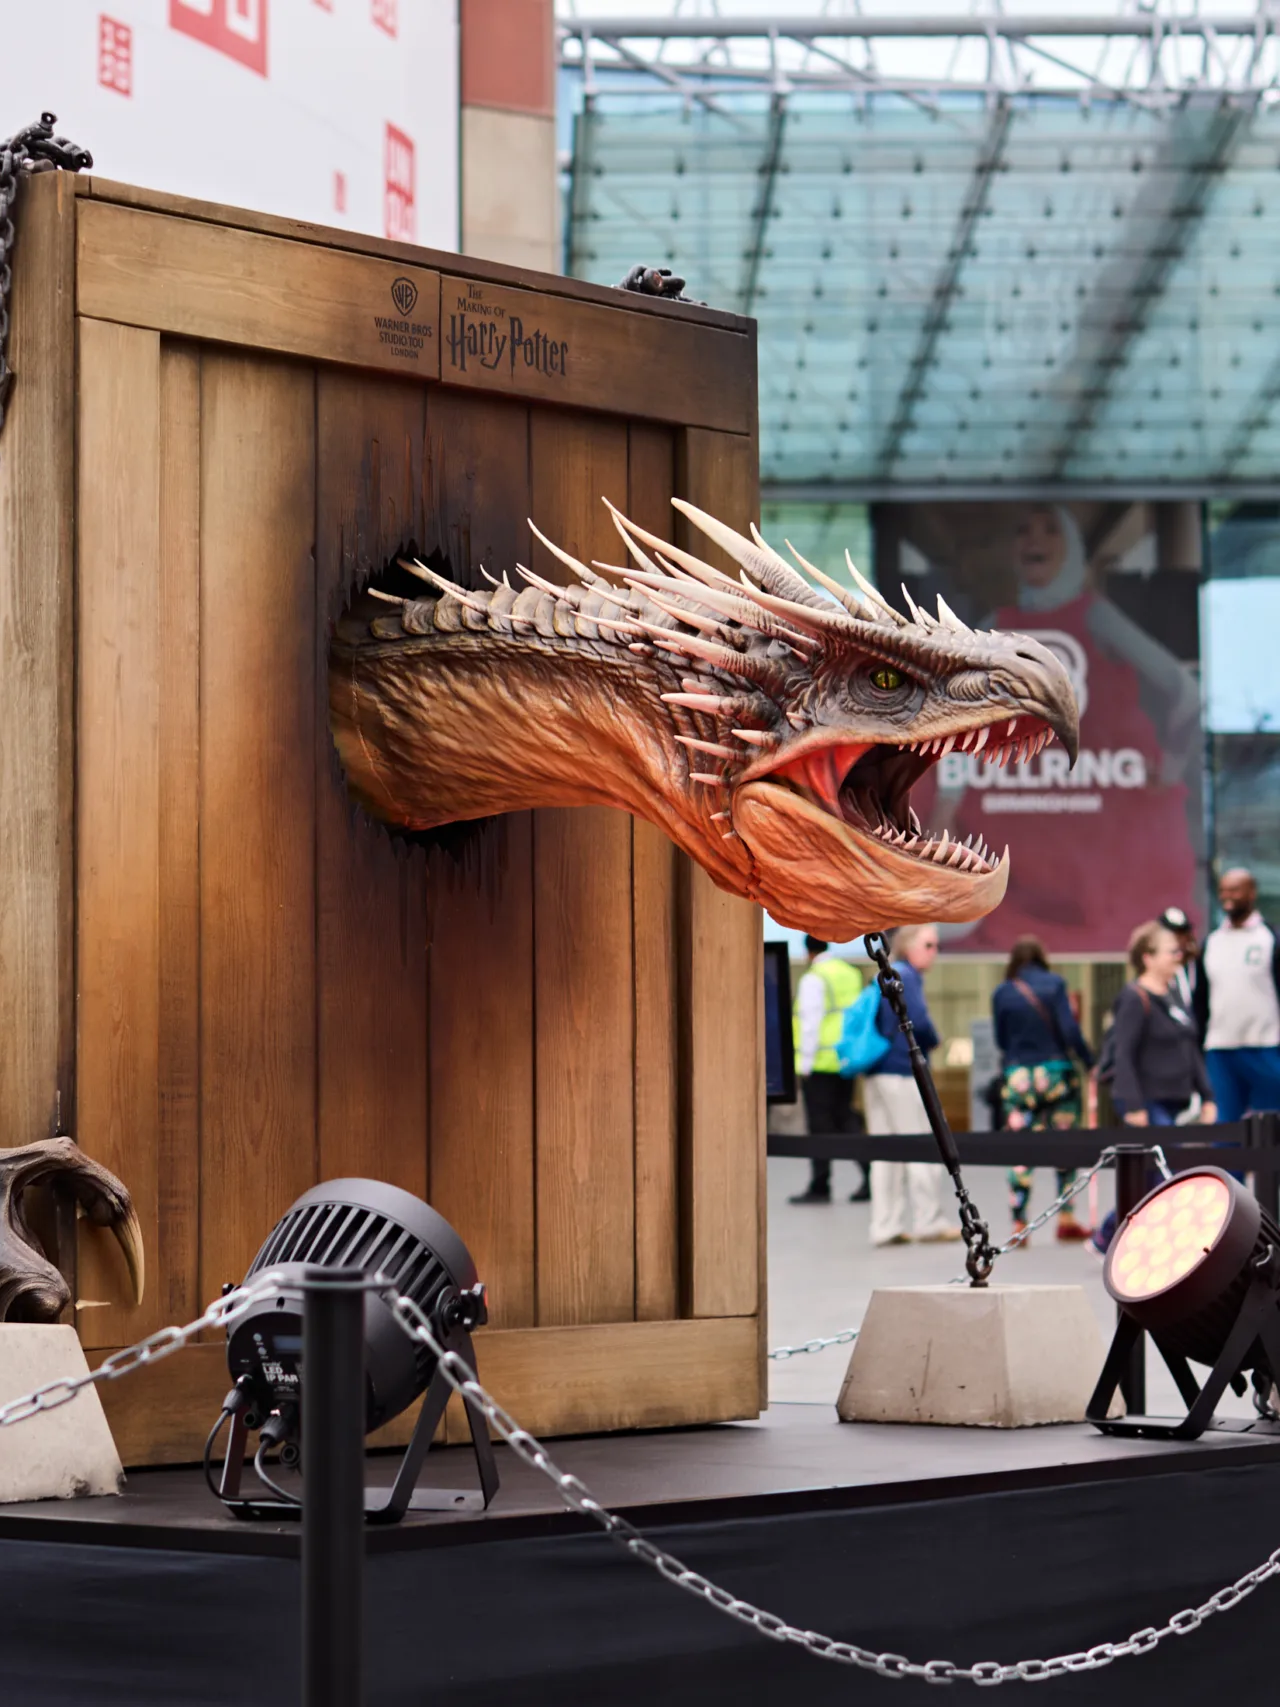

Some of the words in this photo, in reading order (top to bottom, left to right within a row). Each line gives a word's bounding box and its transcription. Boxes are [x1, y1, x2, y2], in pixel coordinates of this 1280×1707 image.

[374, 316, 410, 333] WARNER
[379, 331, 408, 346] STUDIO
[446, 313, 507, 372] Harry
[509, 315, 569, 380] Potter
[390, 346, 419, 360] LONDON
